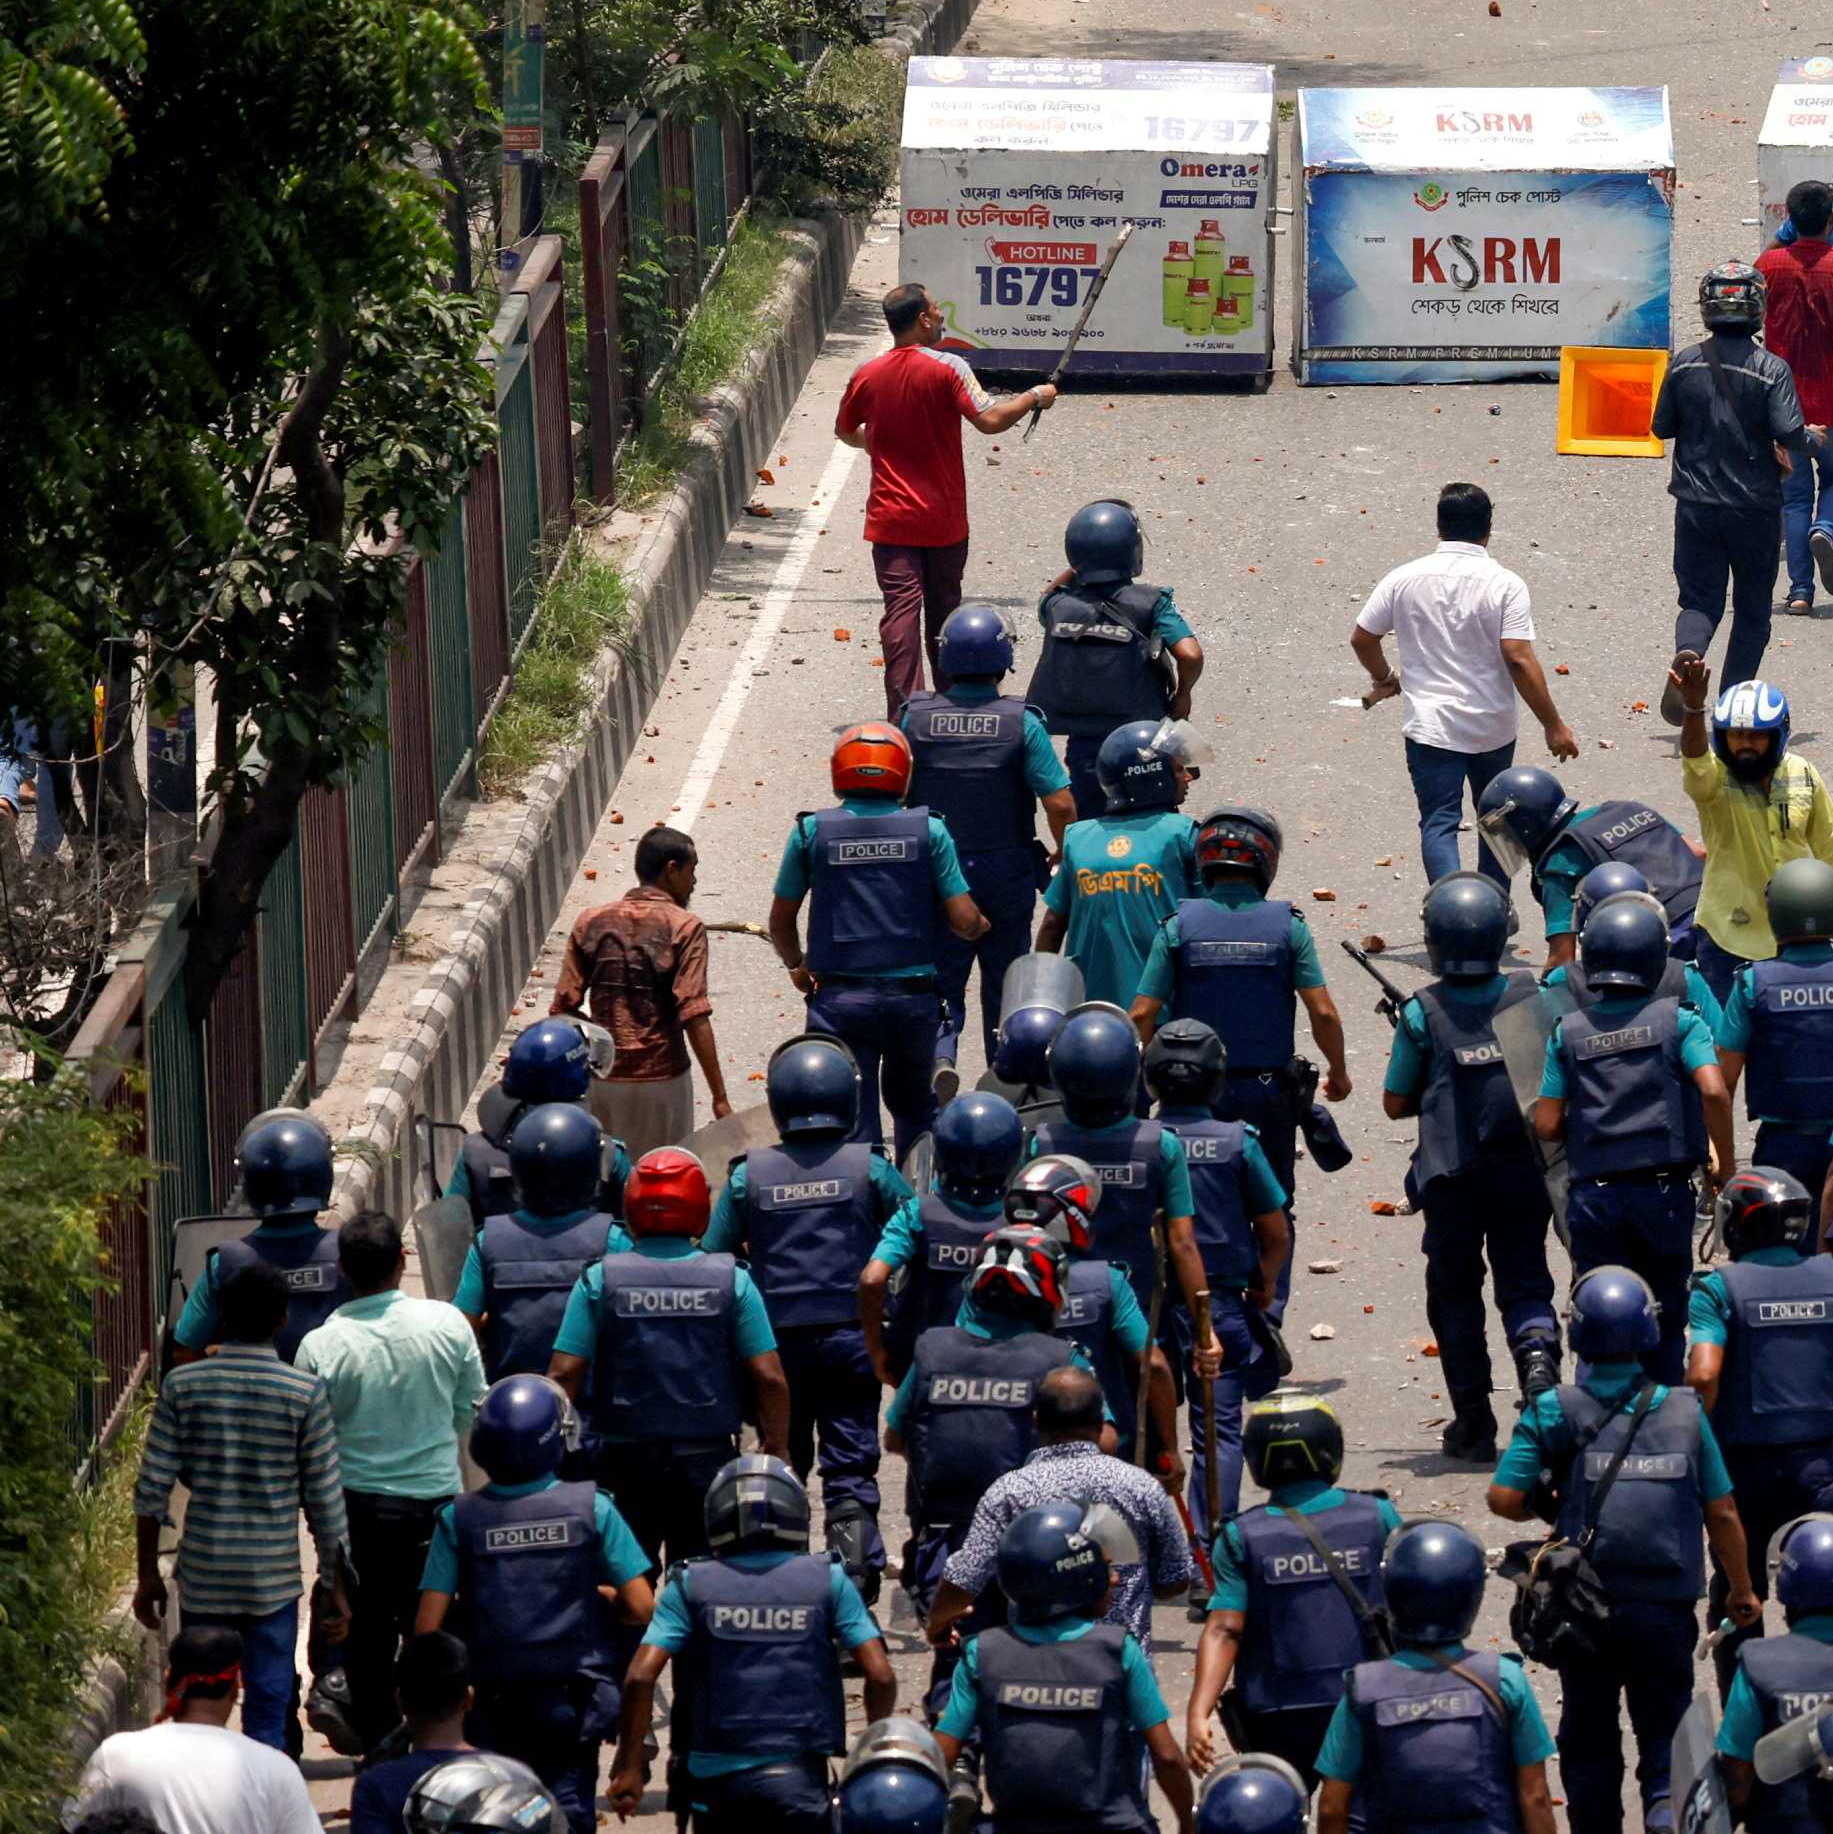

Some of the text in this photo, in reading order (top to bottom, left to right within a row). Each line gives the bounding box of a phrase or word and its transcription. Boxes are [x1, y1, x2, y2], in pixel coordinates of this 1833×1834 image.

[1143, 115, 1260, 143] 16797
[1159, 158, 1247, 178] Omera
[1456, 187, 1562, 208] পুলিশ চেক পোস্ট
[907, 207, 949, 228] হোম
[956, 202, 1050, 228] ডেলিভারি
[1010, 245, 1086, 261] HOTLINE
[1411, 233, 1562, 290] KSRM
[975, 265, 1102, 308] 16797
[1411, 294, 1560, 318] শেকড় থেকে শিখরে
[936, 716, 996, 736] POLICE
[1127, 761, 1163, 777] POLICE
[1602, 810, 1657, 843] POLICE
[845, 845, 899, 860] POLICE
[1077, 867, 1166, 897] ডিএমপি
[1592, 1030, 1646, 1052] POLICE
[784, 1182, 829, 1199] POLICE
[628, 1289, 709, 1313] POLICE
[1770, 1304, 1816, 1318] POLICE
[931, 1379, 1030, 1405] POLICE
[494, 1526, 559, 1545] POLICE
[1056, 1551, 1095, 1572] POLICE
[714, 1607, 809, 1631] POLICE
[1004, 1685, 1099, 1710] POLICE
